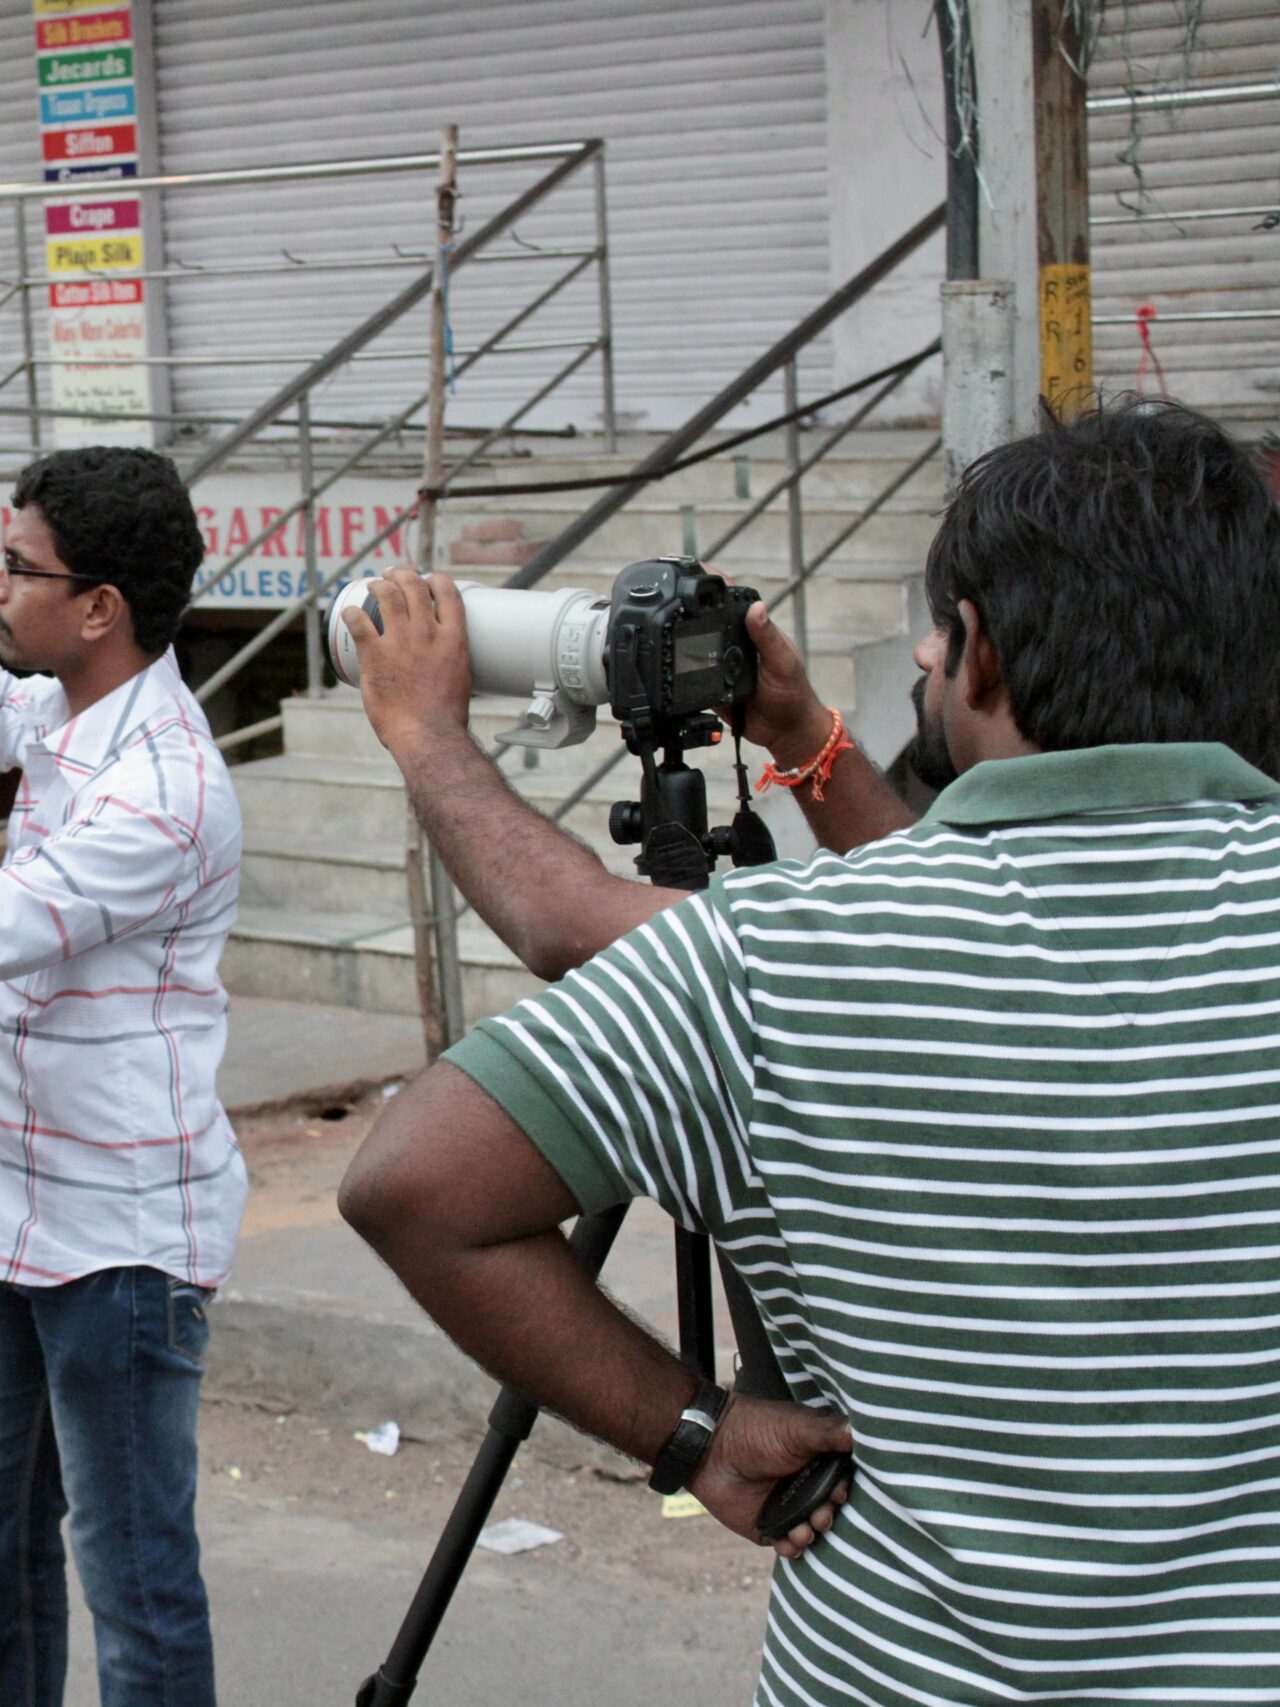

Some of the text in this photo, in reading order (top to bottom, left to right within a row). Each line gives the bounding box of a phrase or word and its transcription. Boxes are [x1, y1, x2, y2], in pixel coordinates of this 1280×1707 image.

[47, 54, 126, 82] Jecards
[70, 204, 115, 230] Crape
[56, 242, 134, 266] Plain Silk
